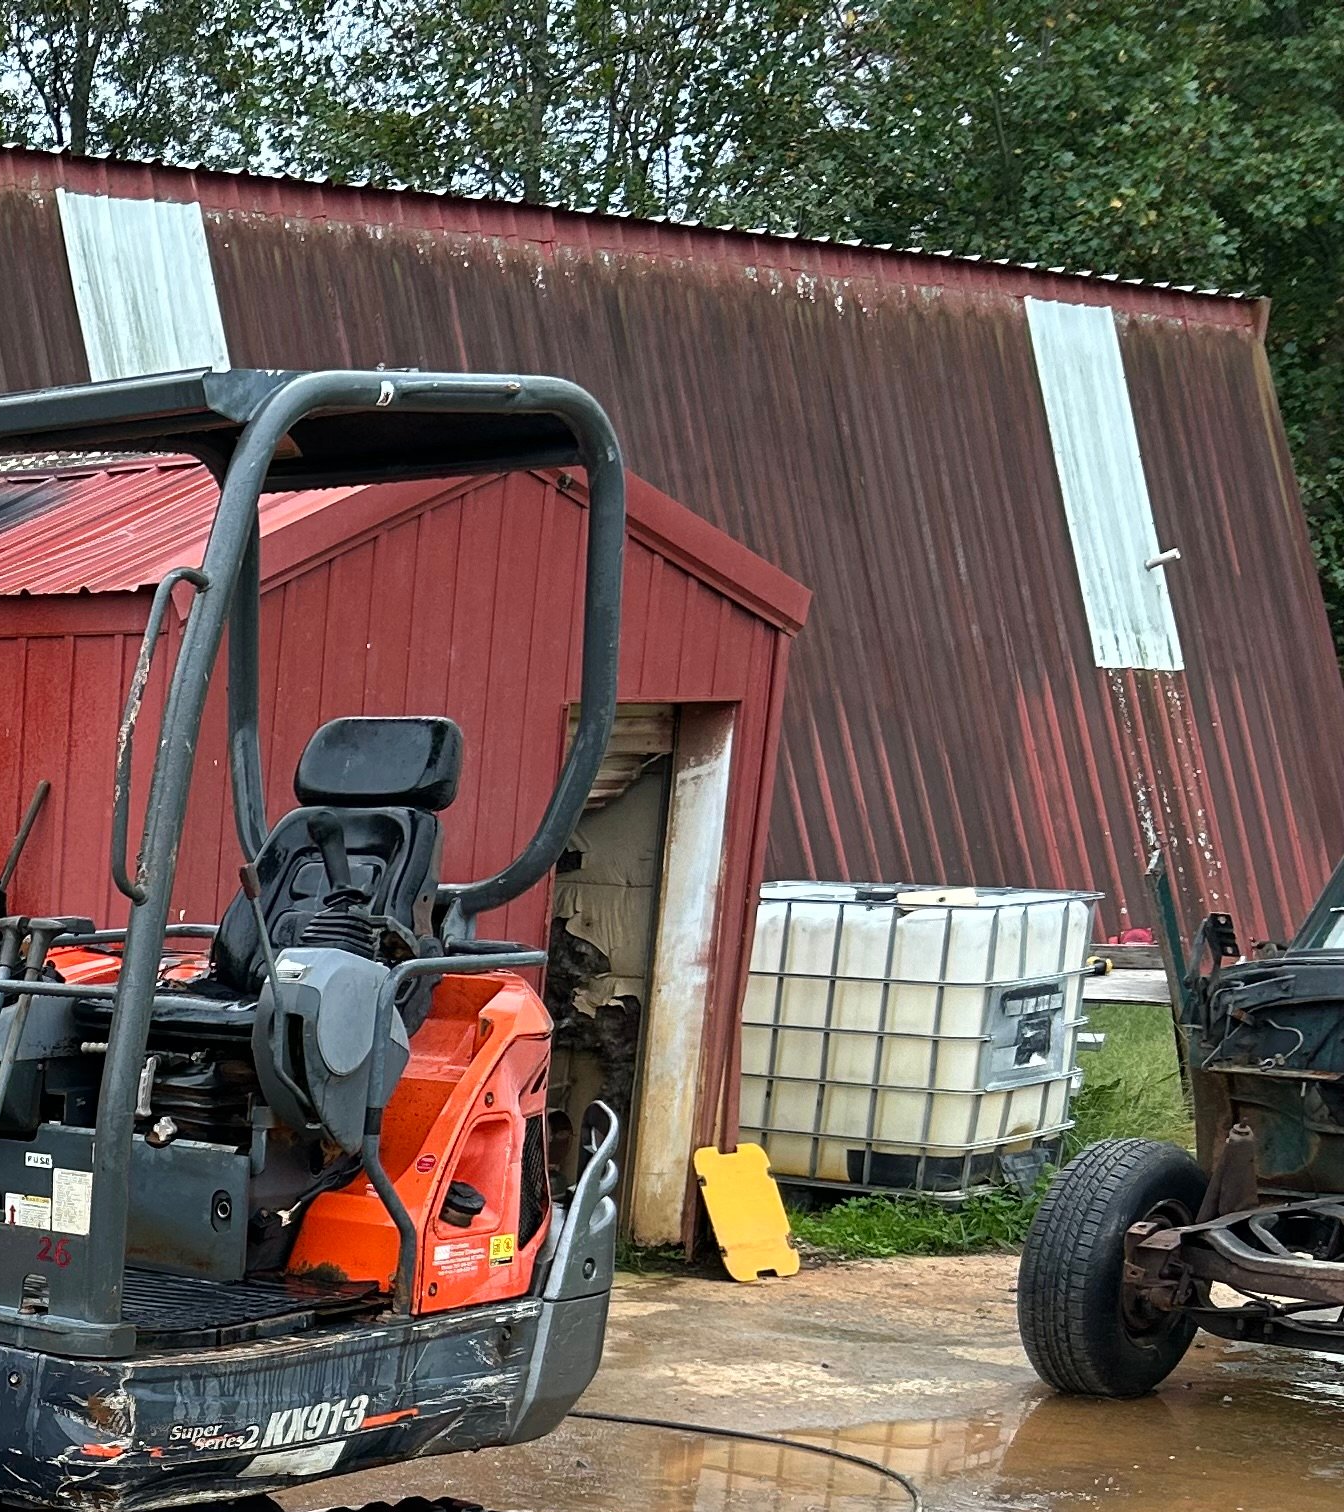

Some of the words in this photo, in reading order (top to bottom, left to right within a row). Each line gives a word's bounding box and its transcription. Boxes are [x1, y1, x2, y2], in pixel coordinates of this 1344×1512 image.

[36, 1236, 72, 1268] 26
[169, 1424, 223, 1443] Super
[262, 1394, 369, 1448] KX91-3
[194, 1434, 245, 1452] Series
[238, 1424, 260, 1451] 2
